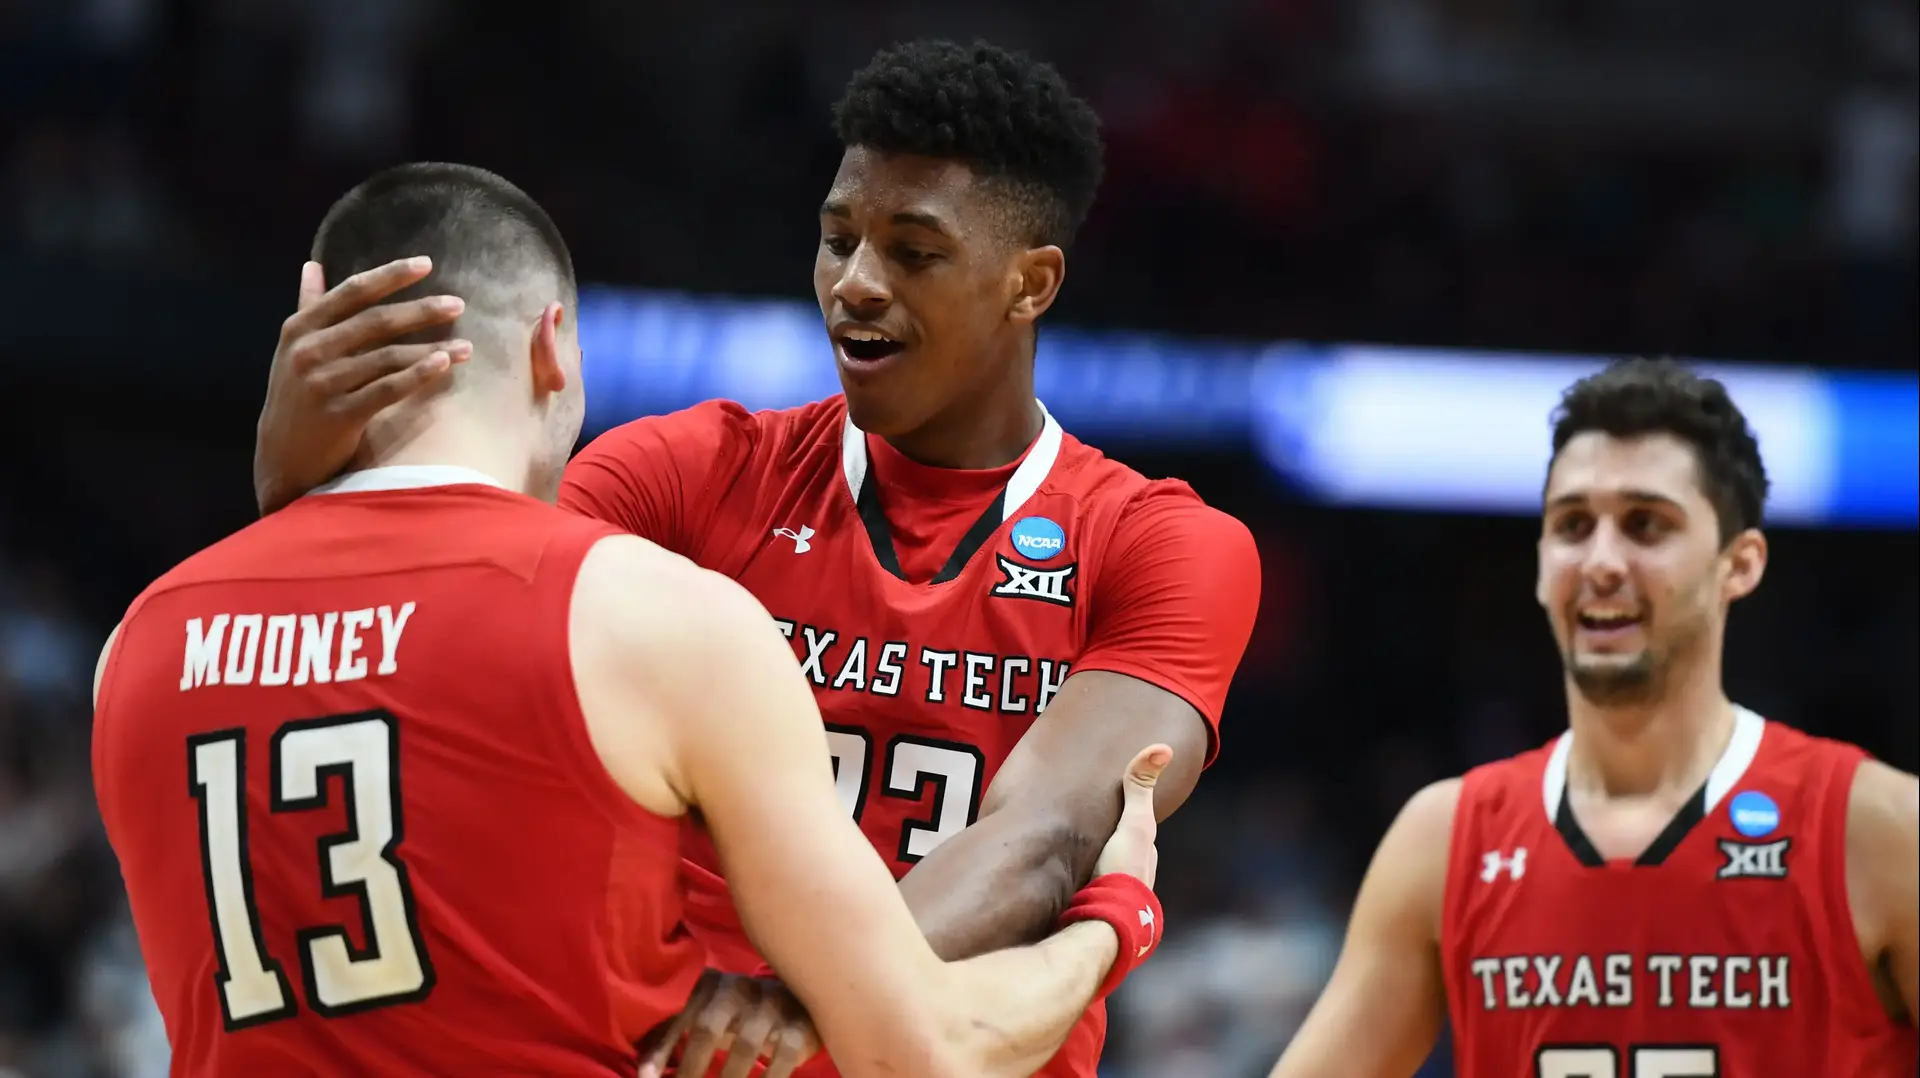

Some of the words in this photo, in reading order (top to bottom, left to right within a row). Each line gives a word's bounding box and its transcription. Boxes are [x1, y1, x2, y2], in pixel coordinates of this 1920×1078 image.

[1018, 534, 1062, 549] NCAA
[995, 558, 1073, 603] XII
[180, 602, 416, 691] MOONEY
[772, 620, 908, 696] XAS
[920, 649, 1072, 715] TECH
[186, 708, 436, 1033] 13
[1718, 839, 1790, 877] XII
[1472, 954, 1633, 1010] TEXAS
[1648, 955, 1791, 1009] TECH
